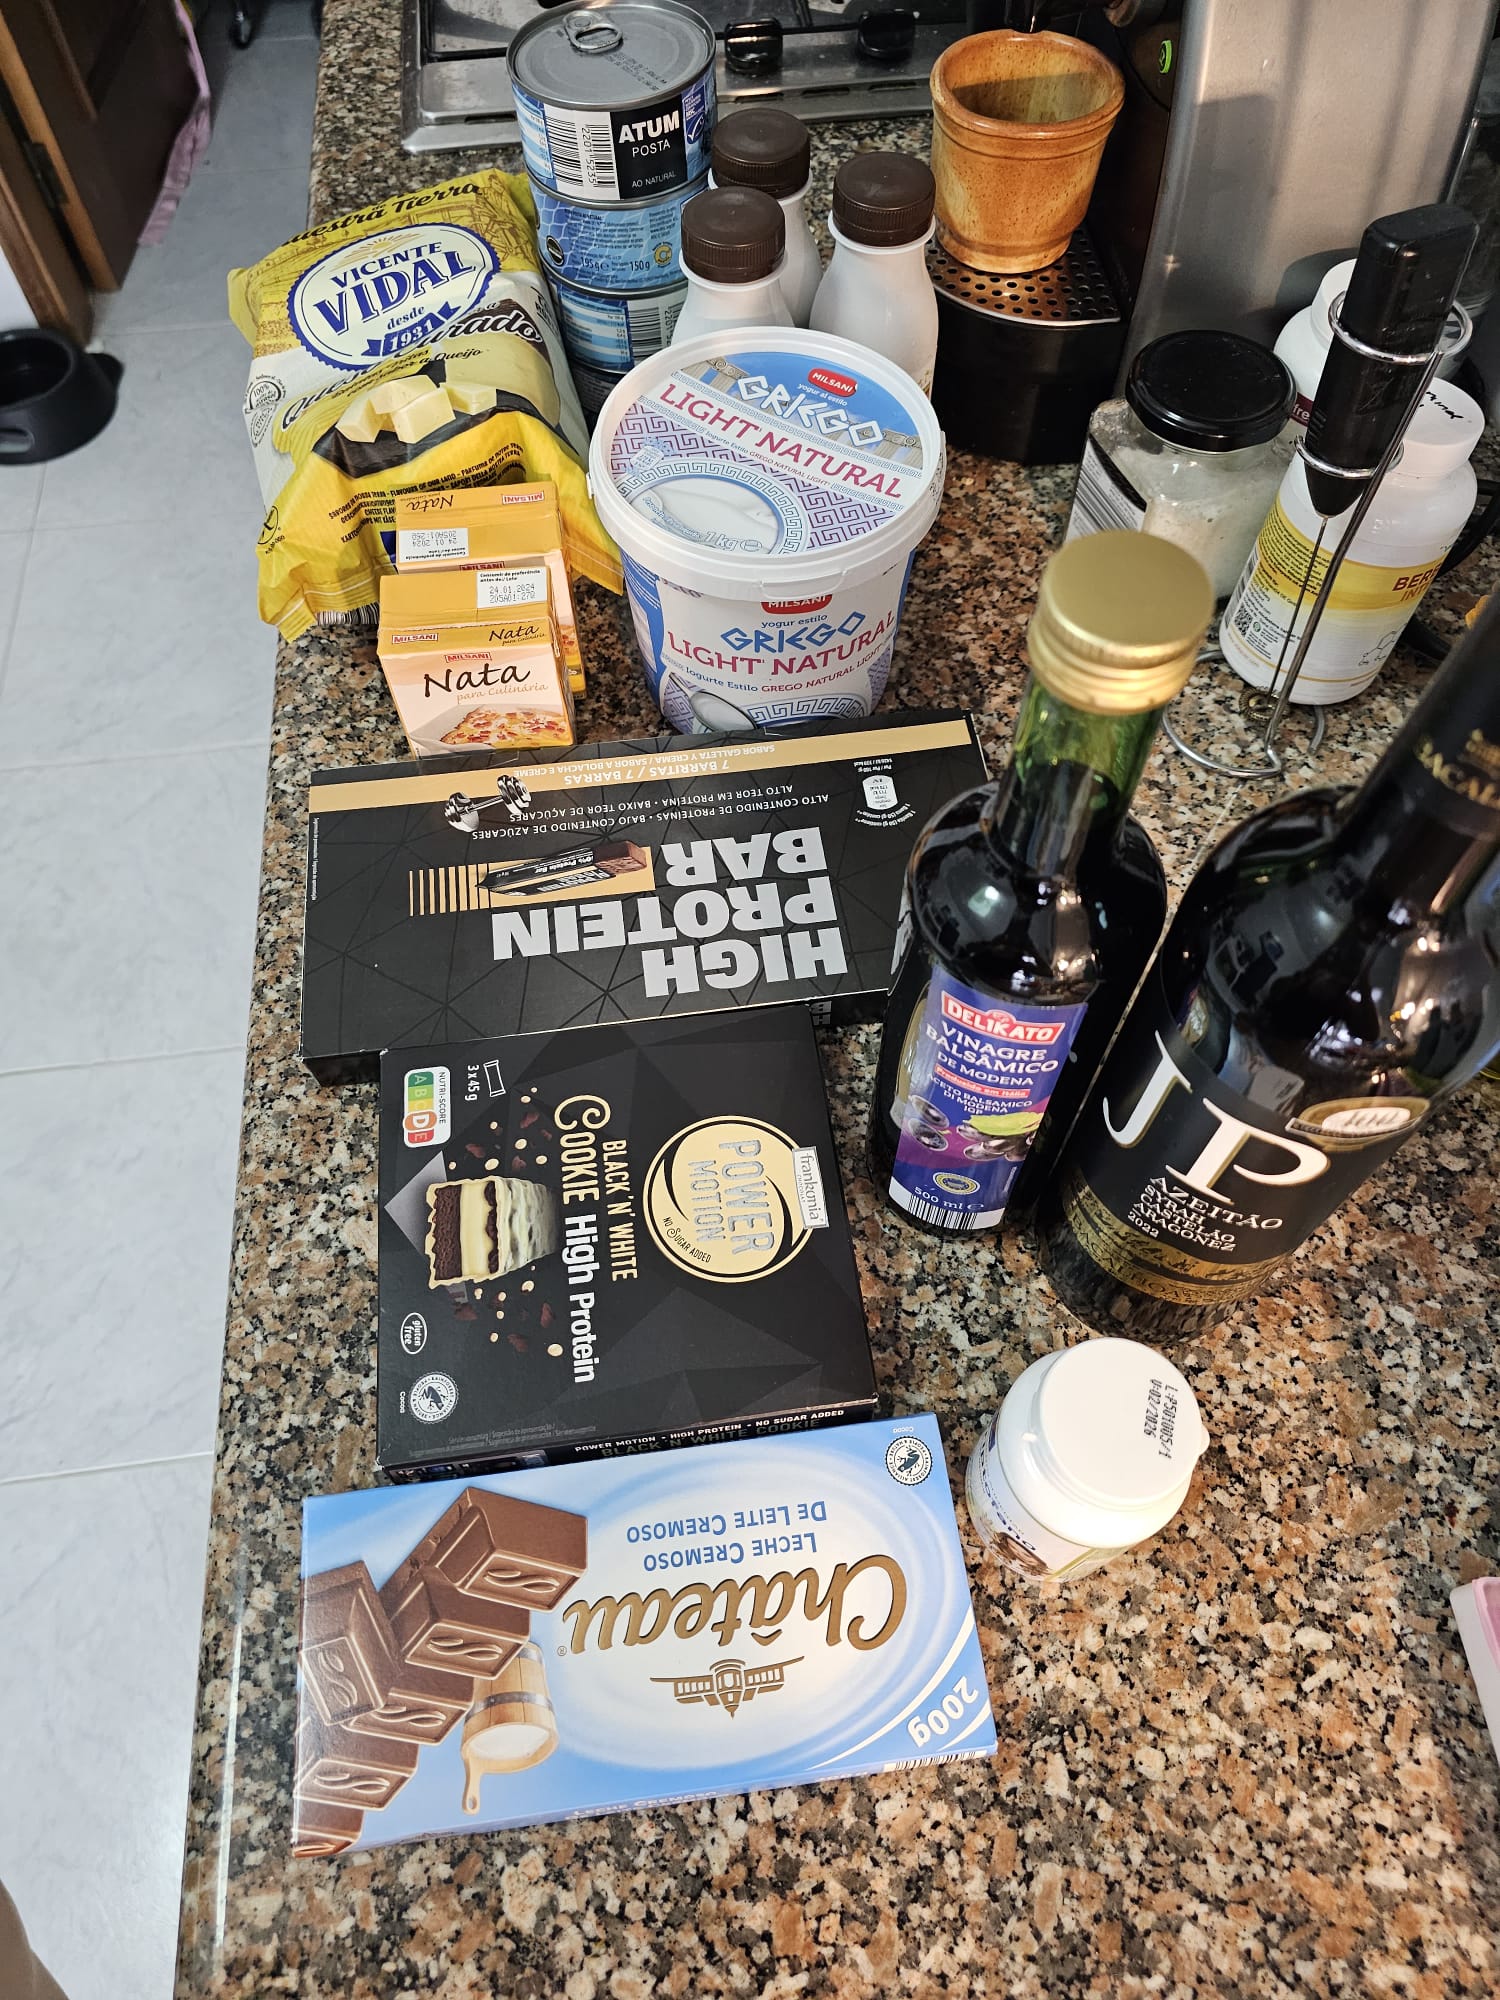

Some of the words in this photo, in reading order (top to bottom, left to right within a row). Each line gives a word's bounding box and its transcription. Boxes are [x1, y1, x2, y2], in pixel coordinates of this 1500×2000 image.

[618, 110, 680, 144] ATUM
[581, 128, 593, 153] 2201
[632, 139, 671, 158] POSTA
[585, 158, 597, 184] 5235
[632, 179, 642, 188] AO
[645, 171, 677, 187] NATURAL
[281, 207, 389, 247] uestra
[392, 182, 483, 214] Tierra
[330, 241, 442, 288] VICENTE
[311, 249, 477, 336] VIDAL
[386, 304, 425, 331] desde
[390, 319, 434, 352] 1931
[812, 372, 853, 393] MILSANI
[797, 383, 820, 396] yogur
[820, 391, 828, 399] al
[828, 395, 848, 407] estilo
[736, 375, 884, 447] GRIEGO
[749, 449, 774, 465] GREGO
[774, 461, 806, 478] NATURAL
[755, 430, 902, 499] NATURAL
[428, 479, 440, 487] OUR
[406, 495, 454, 513] Nata
[503, 492, 544, 503] MILSANI
[716, 533, 738, 552] kg
[1392, 562, 1442, 592] BER
[768, 594, 828, 609] MILSANI
[720, 611, 866, 653] GRIEGO
[761, 619, 796, 629] yogur
[797, 613, 828, 626] estilo
[393, 633, 438, 644] MILSANI
[488, 625, 540, 642] Nata
[771, 610, 895, 676] NATURAL
[446, 653, 491, 663] MILSANI
[685, 665, 725, 688] Iogurte
[727, 680, 758, 693] Estilo
[761, 682, 803, 693] GREGO
[805, 666, 855, 690] NATURAL
[856, 642, 882, 668] LIGHT
[423, 663, 531, 698] Nata
[456, 691, 488, 705] para
[488, 682, 549, 696] Culinária
[655, 755, 689, 764] CREMA
[699, 747, 743, 760] GALLETA
[742, 744, 775, 754] SABOR
[513, 767, 548, 776] CREME
[556, 760, 607, 774] BOLACHA
[614, 757, 648, 767] SABOR
[650, 760, 717, 777] BARRITAS
[722, 759, 729, 770] 7
[564, 769, 621, 785] BARRAS
[626, 770, 633, 780] 7
[661, 793, 713, 808] PROTEÍNA
[717, 791, 733, 801] EM
[736, 787, 764, 799] TEOR
[766, 784, 793, 794] ALTO
[801, 793, 829, 804] ALTO
[509, 808, 566, 823] AÇÚCARES
[570, 806, 584, 816] DE
[587, 803, 616, 814] TEOR
[618, 799, 651, 811] BAIXO
[656, 805, 715, 822] PROTEÍNAS
[719, 804, 733, 814] DE
[736, 797, 799, 813] CONTENIDO
[533, 824, 547, 834] DE
[550, 817, 616, 832] CONTENIDO
[618, 814, 647, 825] BAJO
[471, 826, 530, 840] AZÚCARES
[661, 827, 827, 887] BAR
[491, 876, 838, 962] PROTEIN
[641, 926, 849, 999] HIGH
[947, 999, 1054, 1041] DELIKATO
[926, 1023, 1059, 1074] BALSÂMICO
[941, 1020, 1048, 1062] VINAGRE
[414, 1074, 428, 1085] A
[467, 1064, 480, 1072] 3
[937, 1051, 957, 1069] DE
[959, 1064, 1034, 1086] MODENA
[464, 1093, 478, 1101] g
[467, 1080, 480, 1092] 45
[928, 1073, 962, 1096] ACETO
[963, 1091, 1033, 1108] BALSAMICO
[439, 1072, 447, 1124] NUTRI-SCORE
[943, 1090, 955, 1100] DI
[957, 1098, 1008, 1113] MODENA
[412, 1114, 430, 1128] D
[964, 1106, 983, 1115] IGP
[554, 1094, 612, 1205] COOKIE
[602, 1139, 631, 1195] BLACK
[719, 1139, 775, 1255] POWER
[799, 1152, 822, 1221] frankonia
[914, 1186, 939, 1203] 500
[943, 1200, 963, 1210] ml
[688, 1160, 726, 1242] MOTION
[1144, 1184, 1206, 1224] SYRAH
[1150, 1176, 1283, 1230] AZEITÃO
[662, 1216, 673, 1228] NO
[1127, 1210, 1160, 1238] 2022
[1133, 1202, 1237, 1252] ARAGONEZ
[1140, 1193, 1236, 1244] CASTELÃO
[562, 1213, 601, 1285] High
[607, 1222, 638, 1281] WHITE
[666, 1228, 691, 1252] SUGAR
[689, 1248, 712, 1263] ADDED
[404, 1325, 414, 1345] free
[411, 1320, 423, 1347] gluten
[569, 1292, 601, 1383] Protein
[575, 1441, 612, 1452] POWER
[615, 1436, 656, 1447] MOTION
[670, 1430, 694, 1440] HIGH
[697, 1423, 742, 1435] PROTEIN
[755, 1419, 770, 1427] NO
[773, 1414, 808, 1424] SUGAR
[810, 1409, 845, 1419] ADDED
[602, 1442, 662, 1457] BLACK
[693, 1429, 748, 1445] WHITE
[756, 1419, 821, 1434] COOKIE
[734, 1505, 790, 1529] LEITE
[796, 1500, 827, 1521] DE
[626, 1514, 727, 1544] CREMOSO
[751, 1532, 818, 1558] LECHE
[643, 1541, 745, 1573] CREMOSO
[562, 1553, 907, 1654] Château
[906, 1676, 979, 1748] 200g
